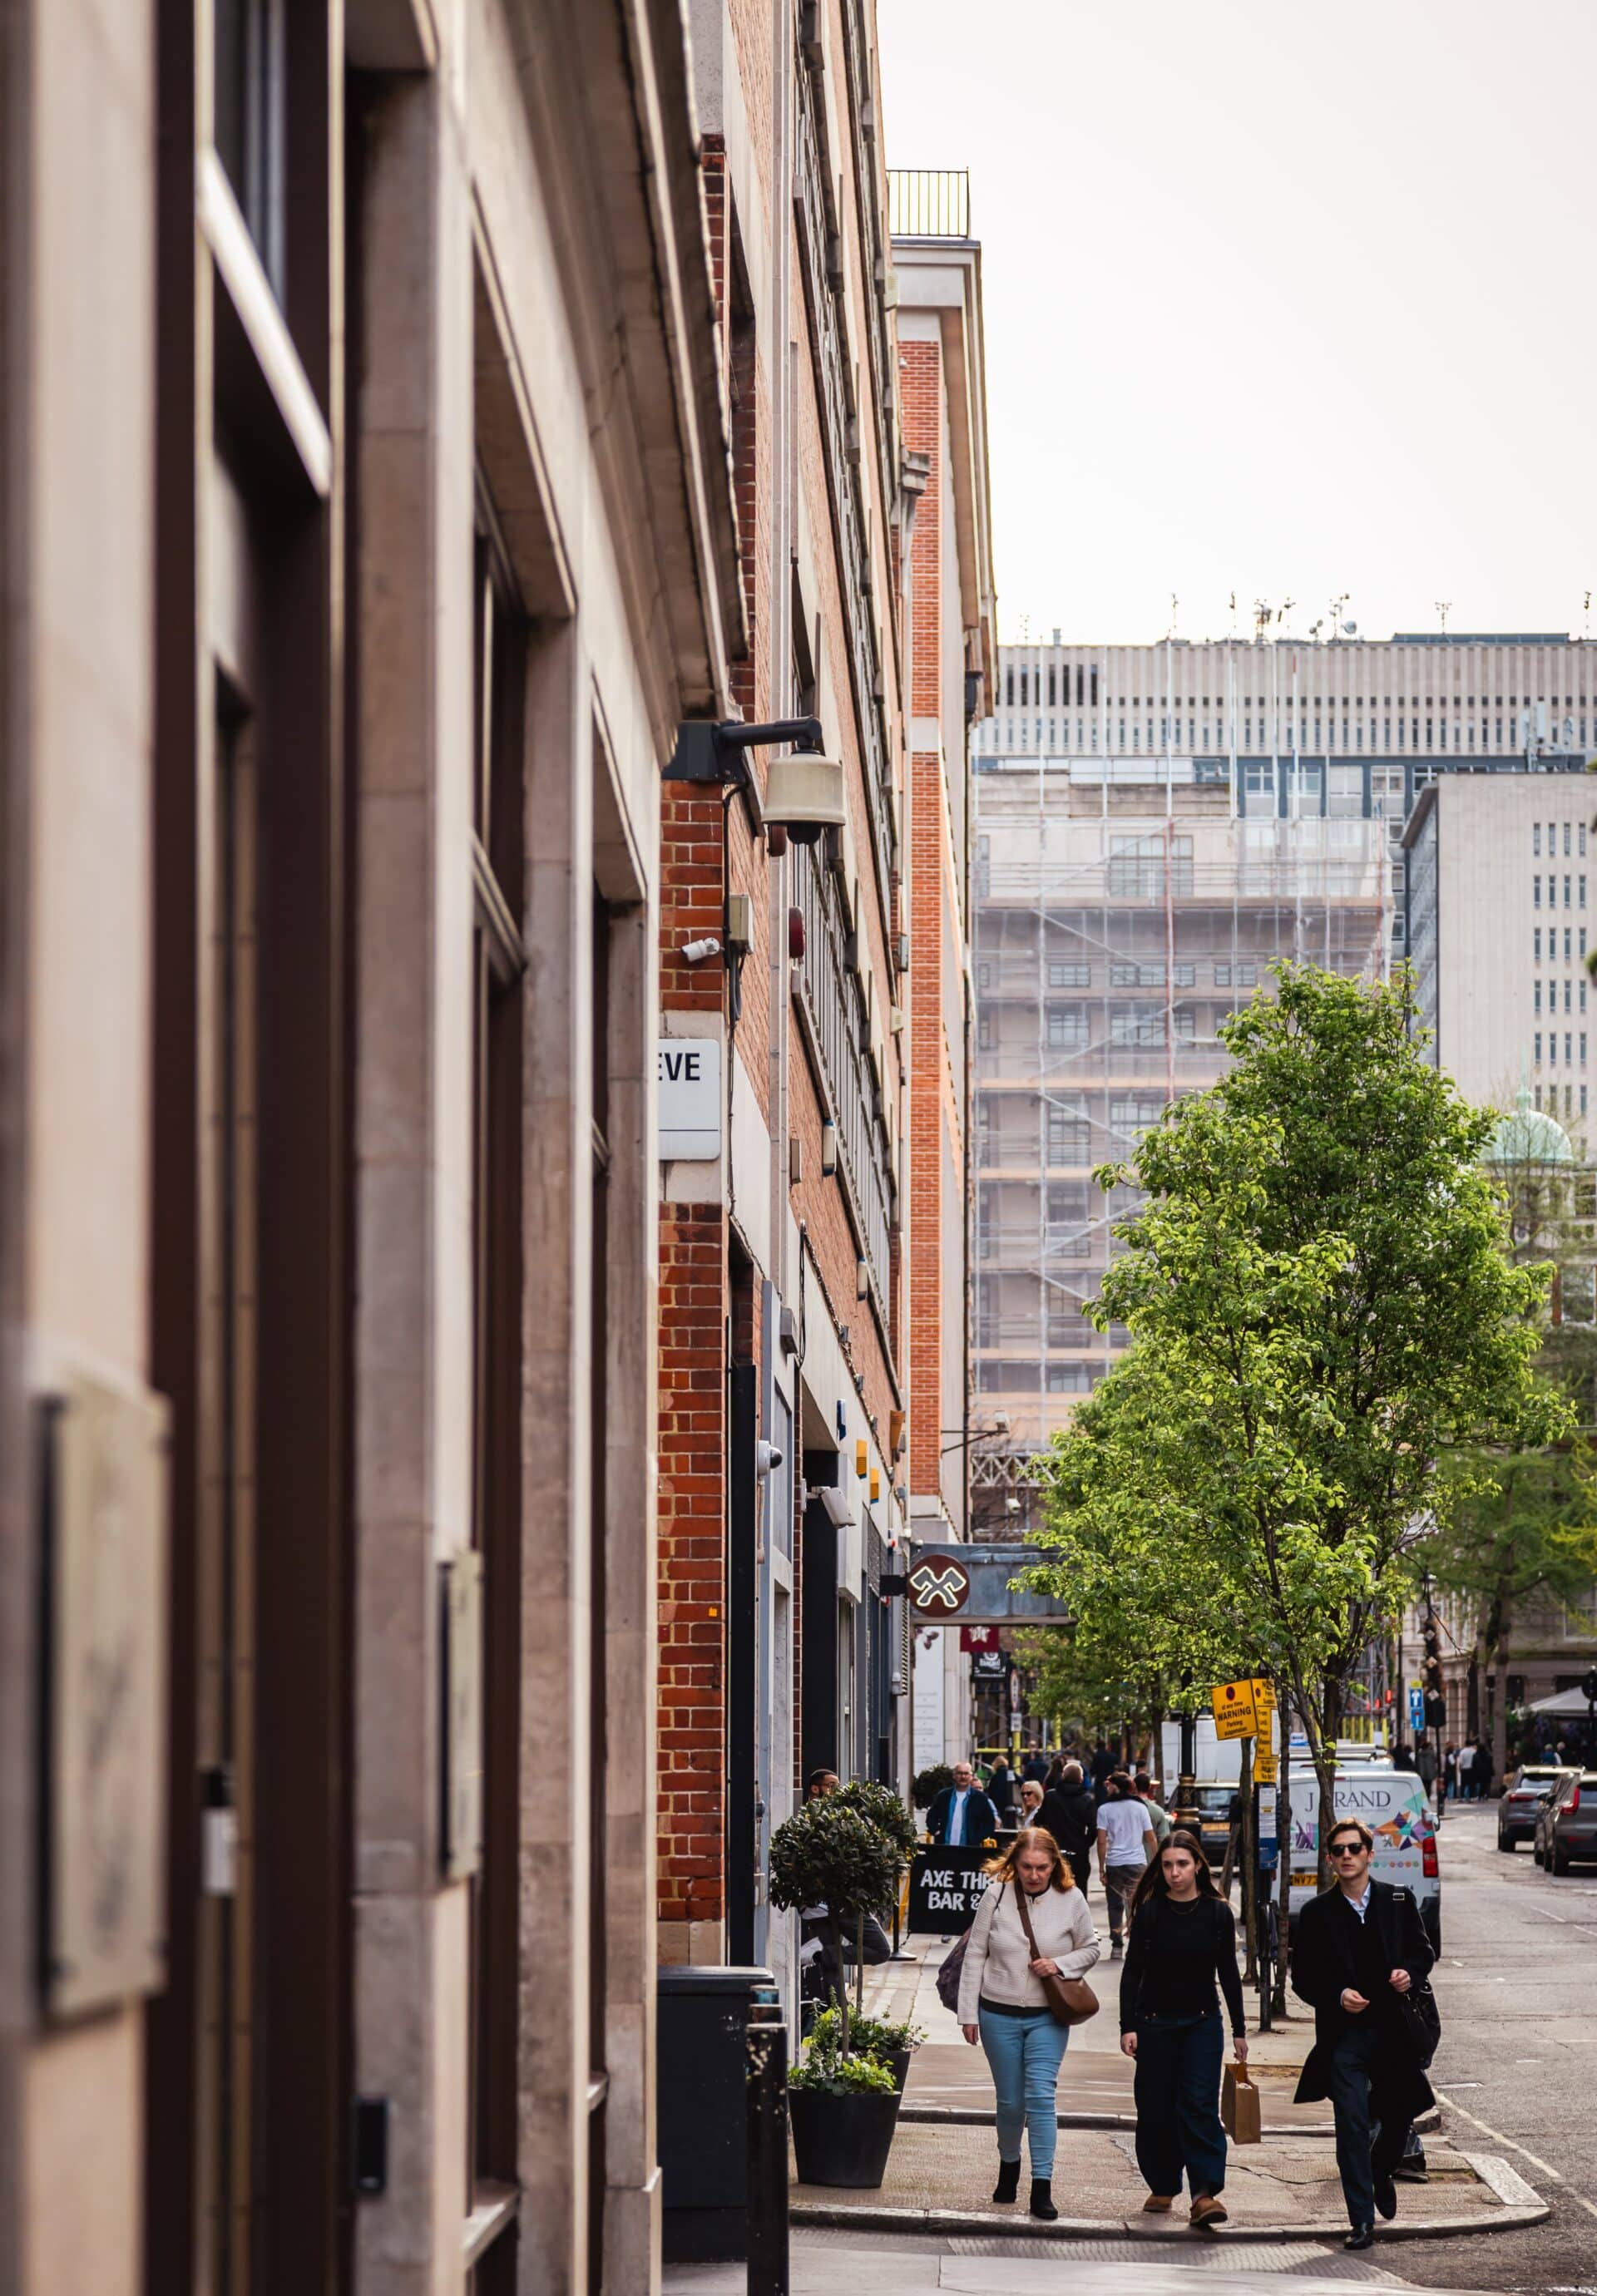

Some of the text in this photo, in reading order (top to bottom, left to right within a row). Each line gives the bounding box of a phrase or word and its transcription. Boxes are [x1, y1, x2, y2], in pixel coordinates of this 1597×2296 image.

[658, 1052, 700, 1081] VE
[1218, 1706, 1251, 1721] WARNING
[1305, 1790, 1392, 1812] J RAND
[920, 1869, 954, 1888] AXE
[927, 1891, 964, 1911] BAR
